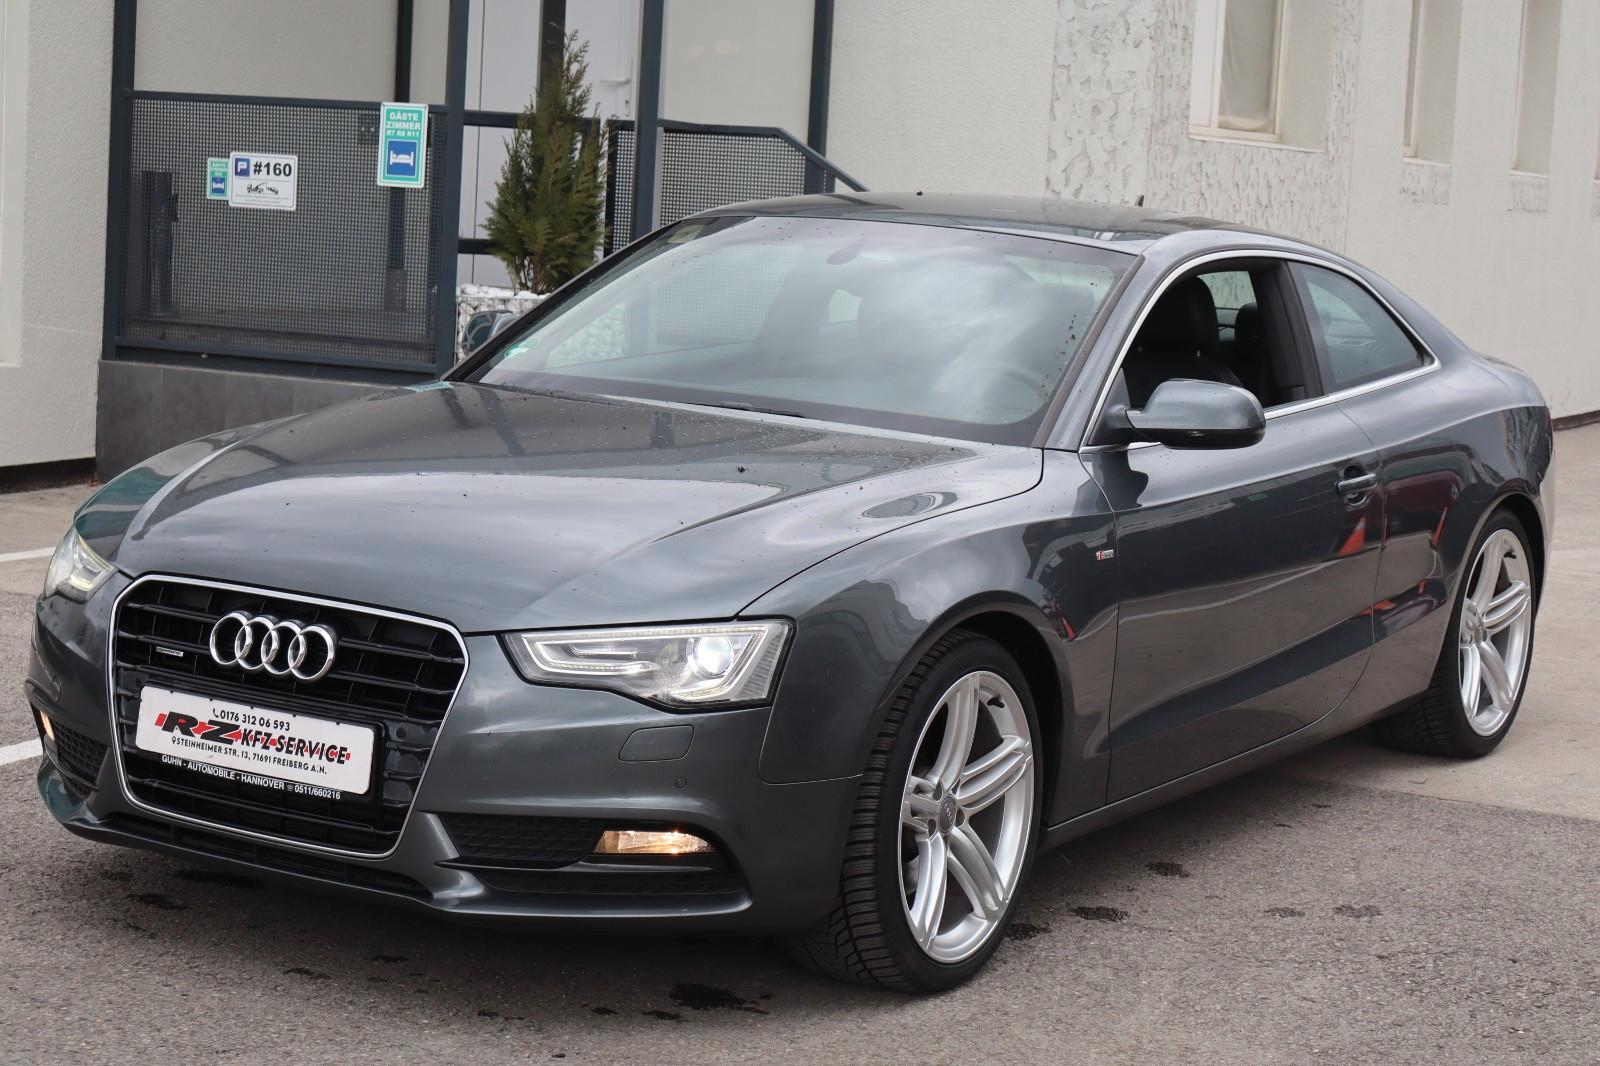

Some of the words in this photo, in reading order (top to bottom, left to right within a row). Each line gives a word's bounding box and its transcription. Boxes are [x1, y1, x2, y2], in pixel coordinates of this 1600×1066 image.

[385, 120, 420, 130] ZIMMER
[389, 111, 419, 121] GÄSTE
[253, 161, 292, 177] #160
[220, 710, 239, 722] 0176
[241, 714, 256, 725] 312
[258, 717, 271, 728] 06
[273, 720, 290, 732] 593
[176, 737, 222, 754] STEINHEIMER
[224, 747, 240, 757] STR.
[241, 750, 251, 760] 13,
[252, 753, 271, 763] 71691
[272, 757, 309, 771] FREIBERG
[161, 754, 183, 767] GUHN
[187, 761, 236, 780] AUTOMOBILE
[241, 773, 285, 791] HANNOVER
[294, 784, 341, 800] 0511/660216
